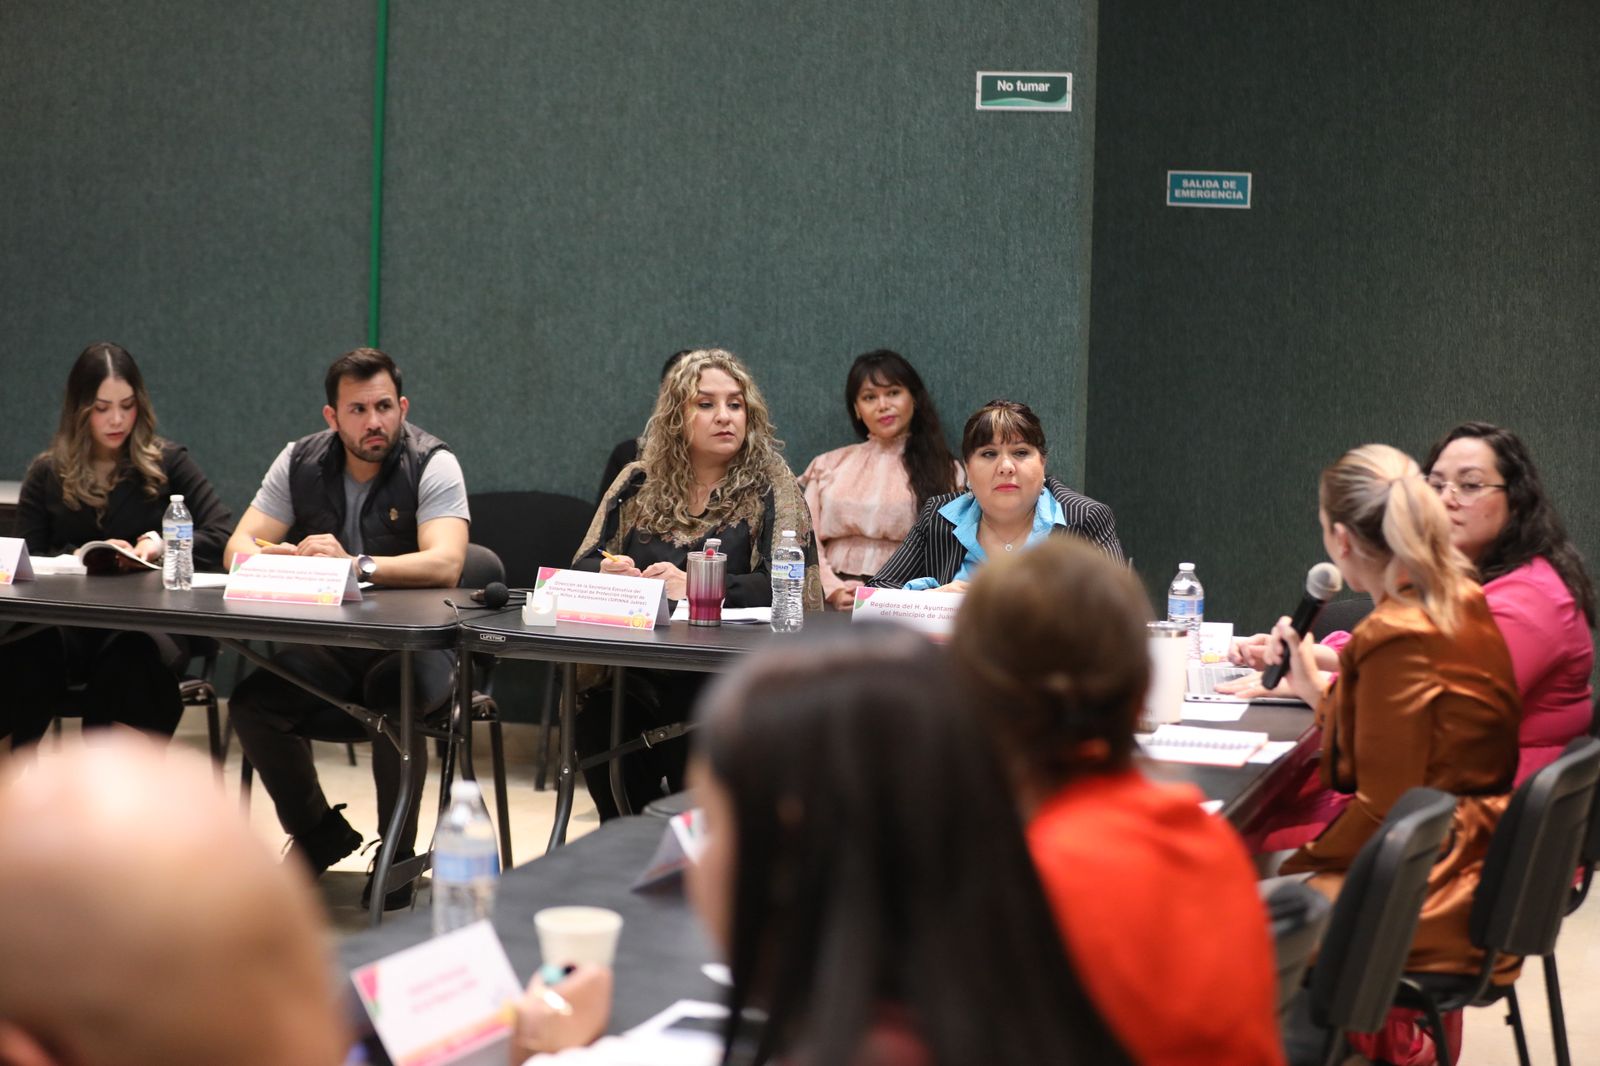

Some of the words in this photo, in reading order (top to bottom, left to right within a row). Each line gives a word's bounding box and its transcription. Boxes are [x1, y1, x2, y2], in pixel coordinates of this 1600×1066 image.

[997, 80, 1014, 92] No
[1016, 80, 1050, 92] fumar
[1182, 179, 1219, 189] SALIDA
[1222, 181, 1237, 190] DE
[1174, 189, 1244, 200] EMERGENCIA
[870, 601, 900, 609] Regidora
[892, 610, 925, 618] Municipio
